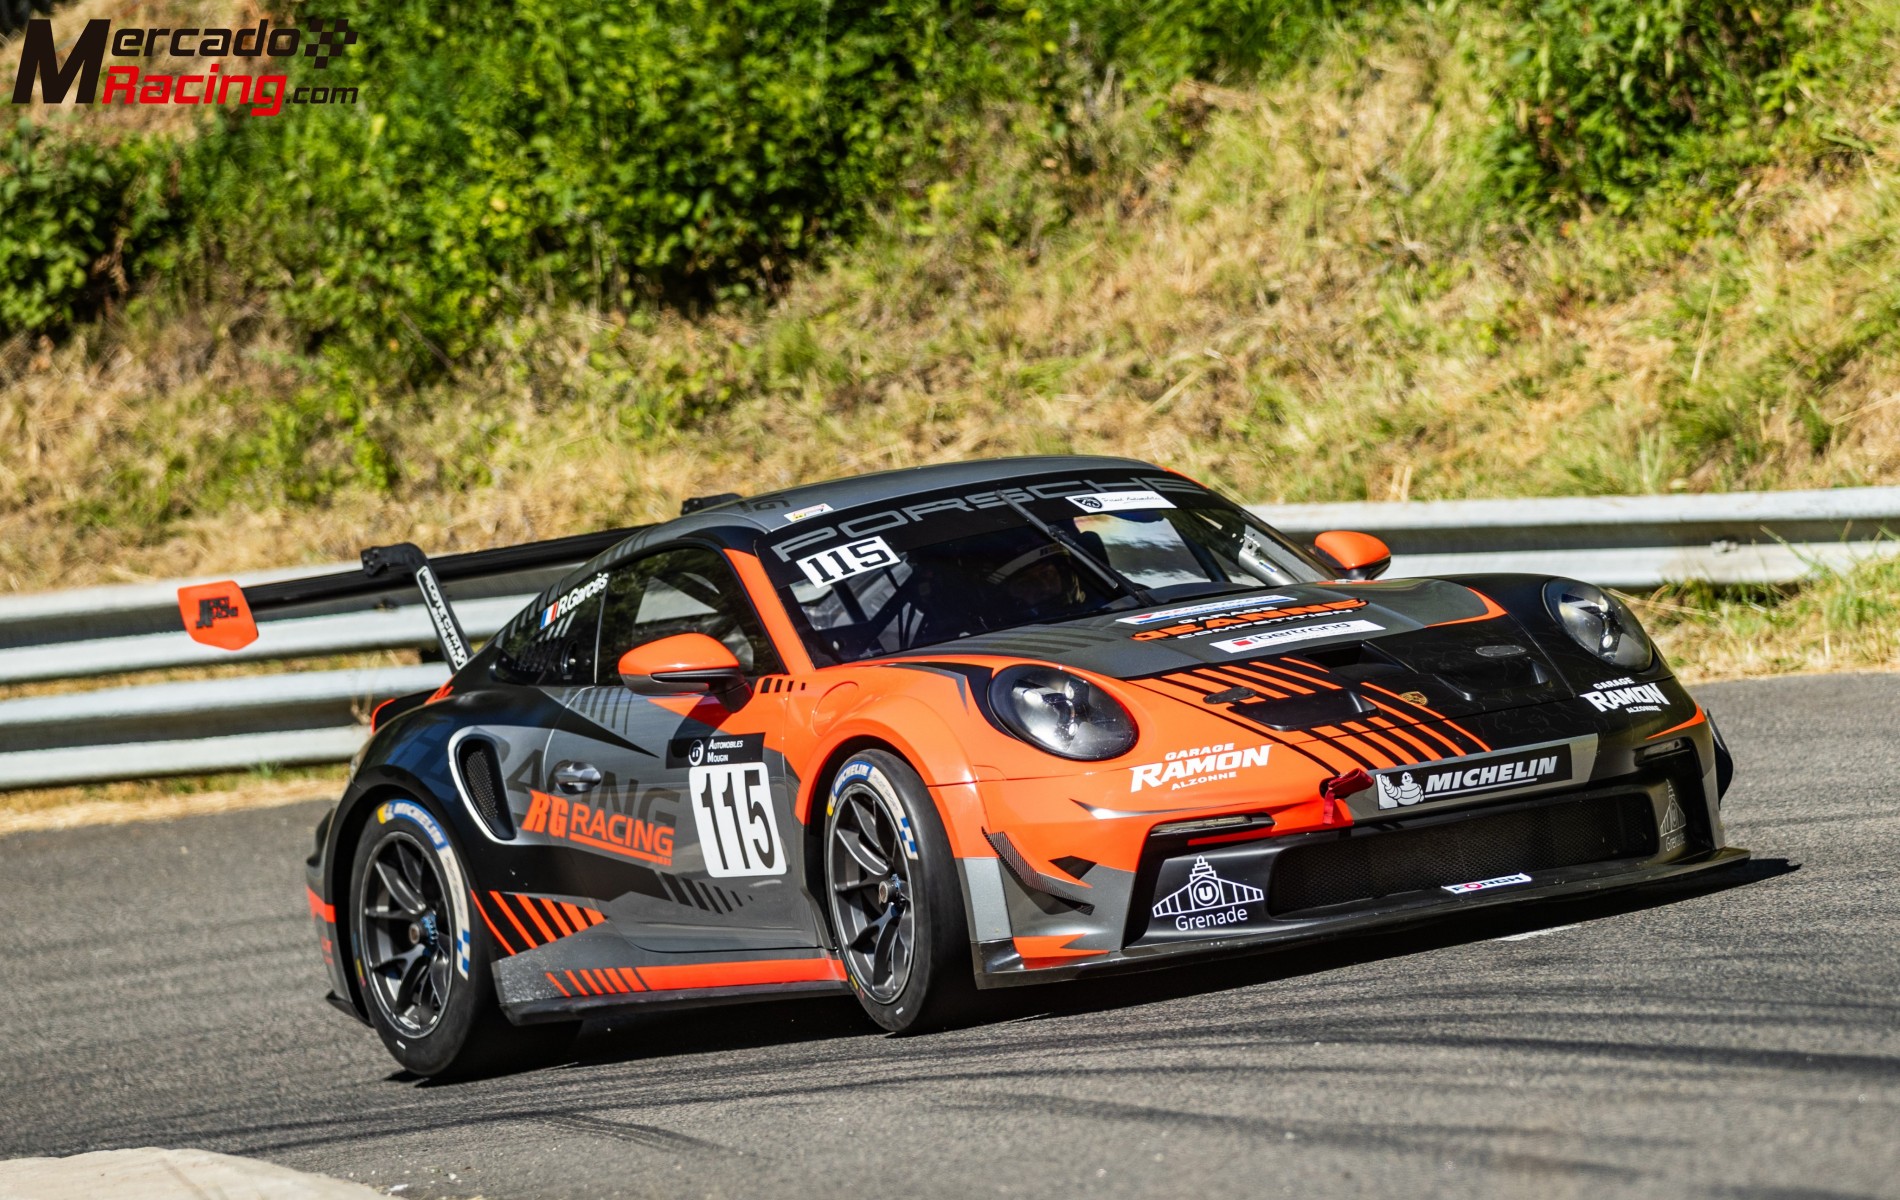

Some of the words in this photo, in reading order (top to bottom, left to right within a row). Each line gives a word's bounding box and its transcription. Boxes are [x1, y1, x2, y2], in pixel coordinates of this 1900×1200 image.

[771, 477, 1209, 562] PORSCHE
[807, 540, 891, 584] 115
[1131, 598, 1369, 642] JEANNE
[1178, 606, 1278, 624] GARAGE
[1256, 621, 1351, 641] bertrand
[1579, 683, 1671, 712] RAMON
[1593, 677, 1636, 690] GARAGE
[1129, 744, 1273, 793] RAMON
[1164, 743, 1235, 761] GARAGE
[1171, 771, 1237, 791] ALZONNE
[1425, 756, 1558, 793] MICHELIN
[521, 789, 569, 838] RG
[570, 803, 676, 857] RACING
[700, 769, 775, 870] 115
[1175, 905, 1248, 932] Grenade
